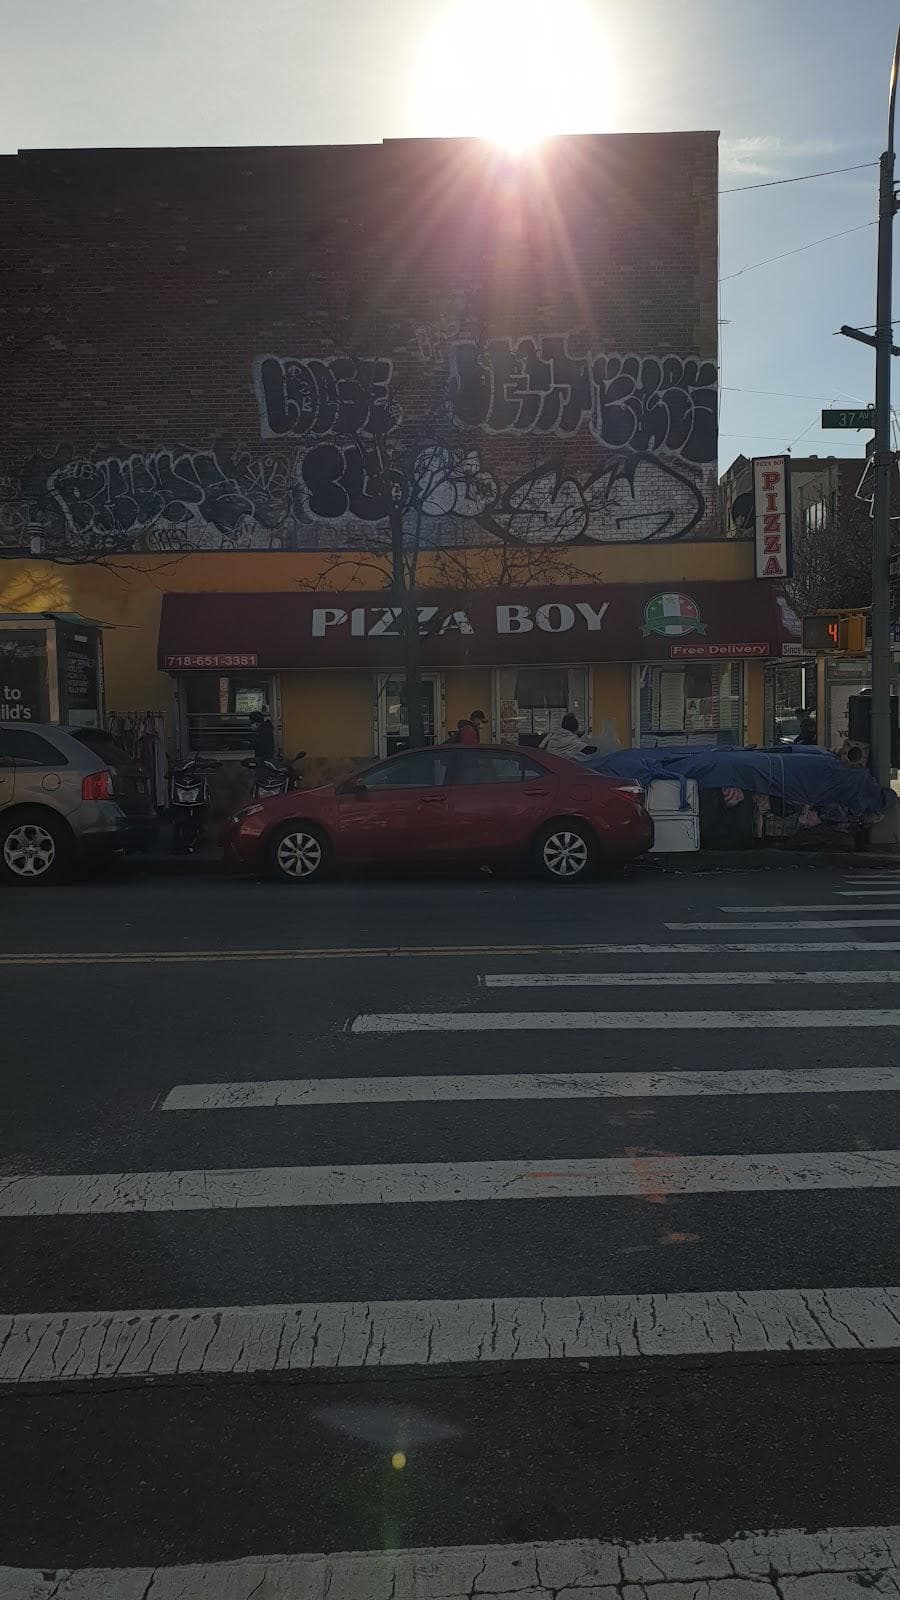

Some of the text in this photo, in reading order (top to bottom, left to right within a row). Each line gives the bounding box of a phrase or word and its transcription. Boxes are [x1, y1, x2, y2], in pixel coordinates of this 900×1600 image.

[839, 412, 856, 426] 37
[762, 472, 784, 576] PIZZA
[495, 602, 610, 634] BOY
[827, 623, 839, 642] 4
[673, 645, 768, 656] Free Delivery
[783, 644, 801, 654] Since
[167, 655, 255, 666] 718-651-3381
[4, 685, 22, 700] to
[0, 704, 32, 720] ild's
